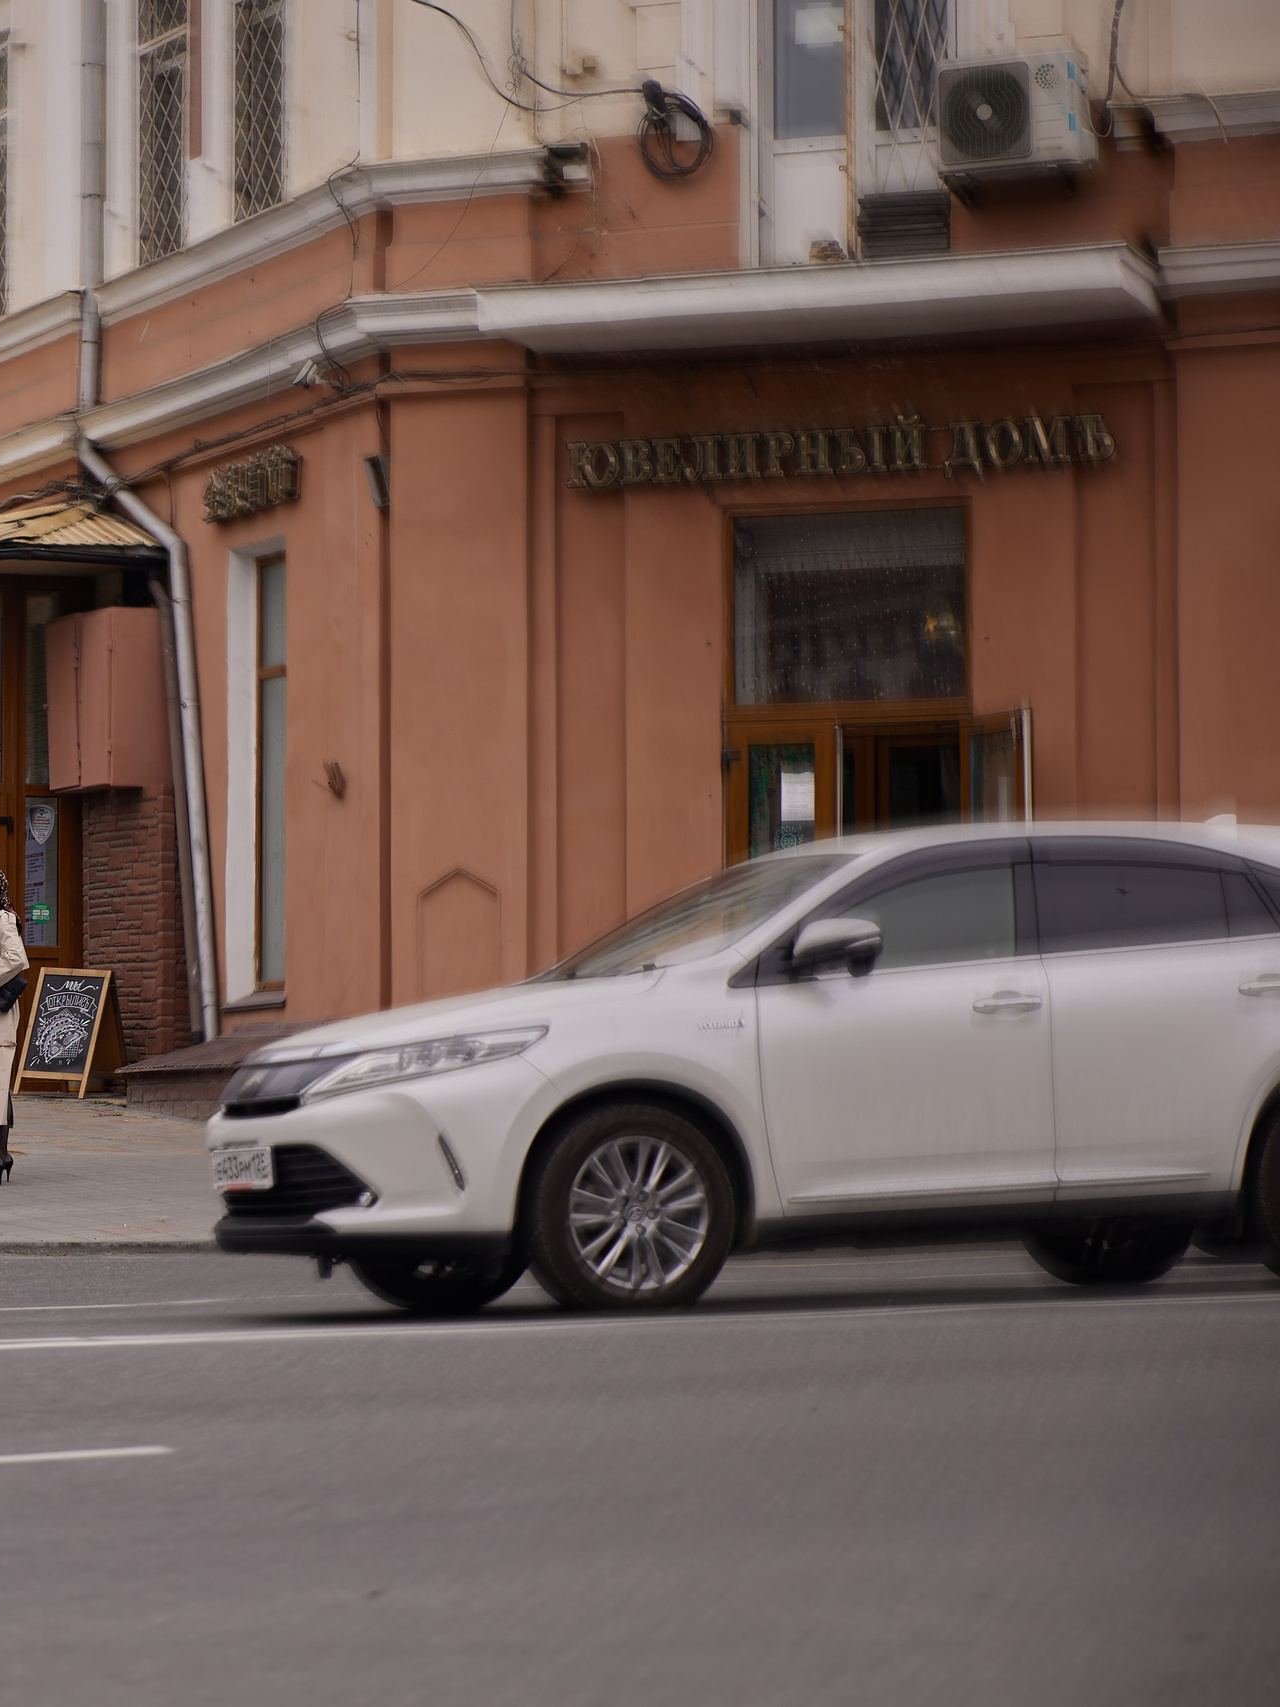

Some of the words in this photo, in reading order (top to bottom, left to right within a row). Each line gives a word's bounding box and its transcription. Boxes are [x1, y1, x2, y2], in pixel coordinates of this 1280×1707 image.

[566, 413, 926, 488] ЮВЕЛИРНЫЙ
[942, 414, 1116, 479] ДОМЪ
[48, 994, 90, 1008] ОТКРЫЛИСЬ
